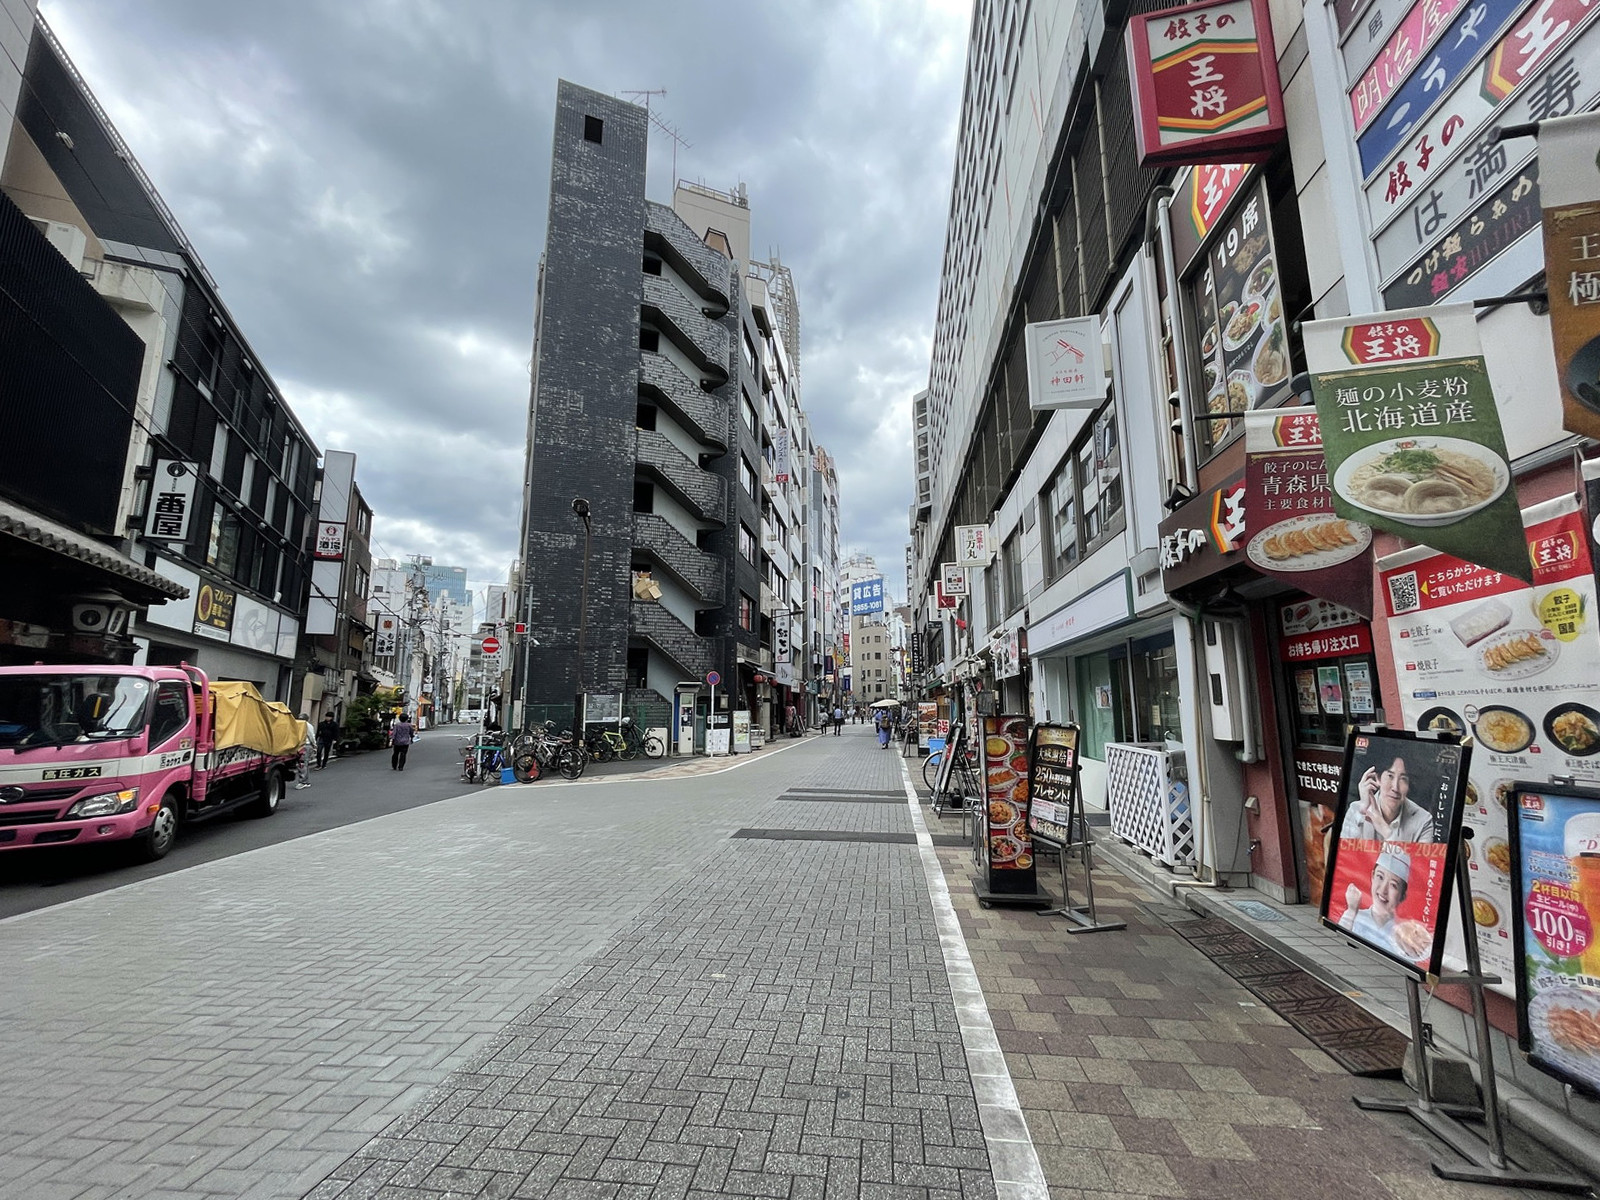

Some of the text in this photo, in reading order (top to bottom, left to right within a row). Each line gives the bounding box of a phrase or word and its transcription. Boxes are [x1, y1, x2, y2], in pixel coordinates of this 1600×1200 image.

[1164, 14, 1236, 41] 餃子の
[1187, 55, 1228, 118] 王将
[1385, 114, 1464, 204] 餃子の
[1368, 325, 1409, 338] 餃子の
[1362, 336, 1422, 360] 王将
[1335, 377, 1469, 408] 麺の小麦粉
[1342, 399, 1477, 434] 北海道産
[1262, 473, 1332, 495] 青森県
[1539, 544, 1573, 565] 王将
[1429, 564, 1486, 584] こちらからメ
[1430, 572, 1502, 599] ご覧いただけます
[1288, 635, 1360, 657] お持ち帰り注文口
[44, 768, 100, 780] 高圧ガス
[1296, 760, 1342, 776] できたて中華お持
[1298, 775, 1339, 793] TEL03-5
[1413, 843, 1447, 860] 2024
